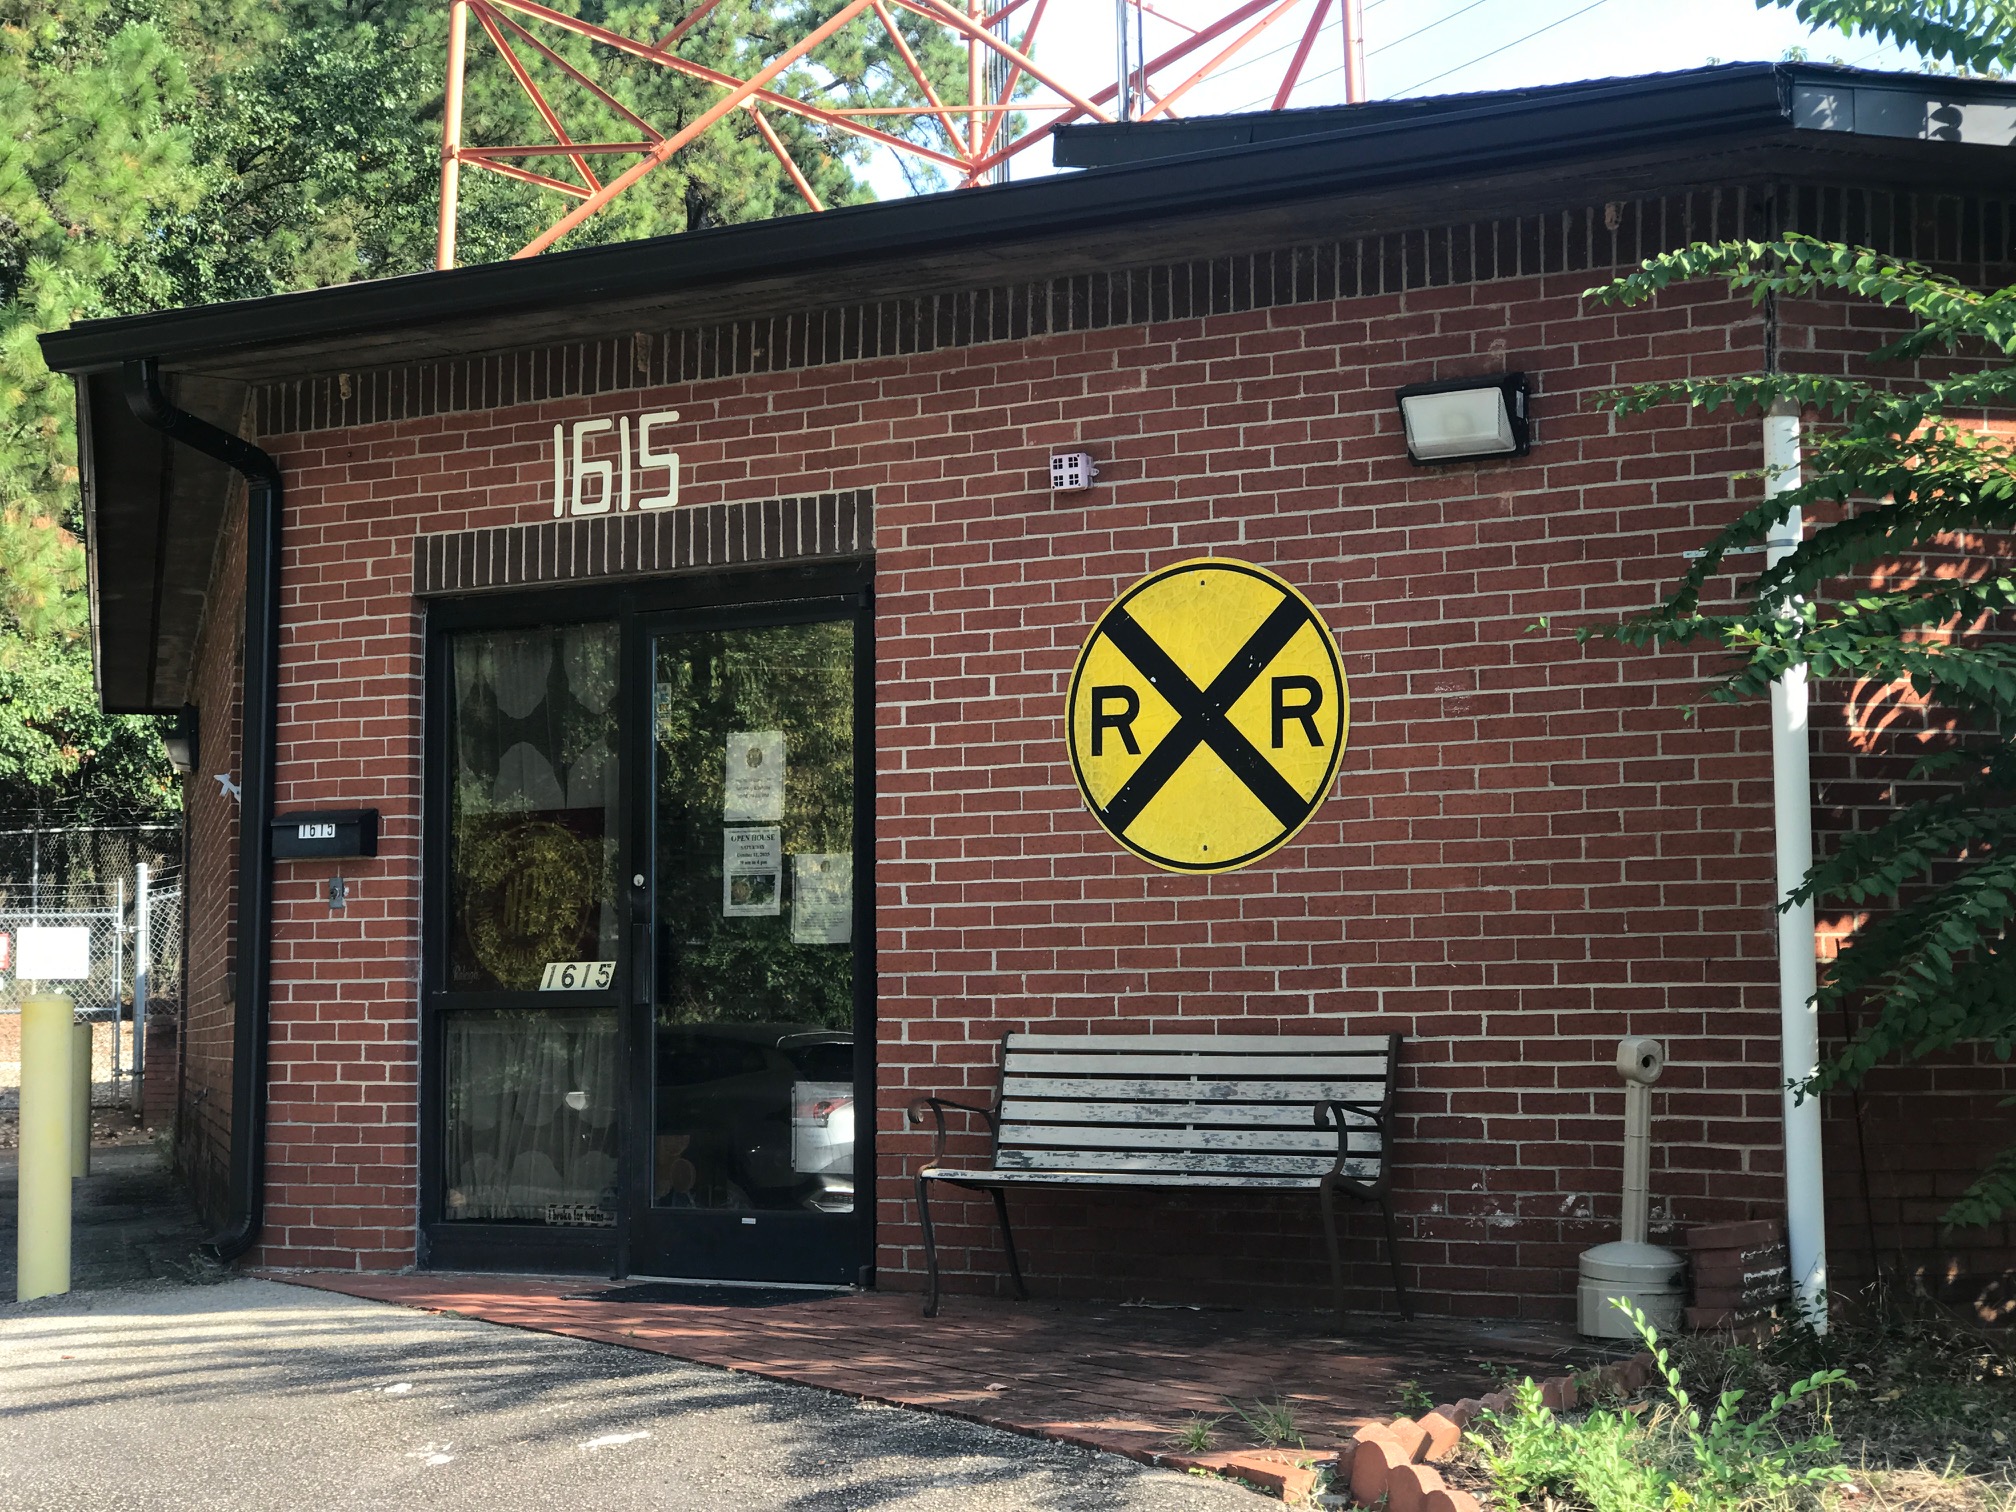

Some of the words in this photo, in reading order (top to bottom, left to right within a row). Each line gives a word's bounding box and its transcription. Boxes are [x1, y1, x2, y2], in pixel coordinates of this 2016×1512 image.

[553, 410, 680, 518] 1615
[1091, 685, 1141, 757] R
[1271, 674, 1325, 749] R
[302, 824, 333, 837] 1615
[731, 834, 750, 842] OPEN
[547, 963, 612, 988] 1615
[573, 1209, 583, 1221] for
